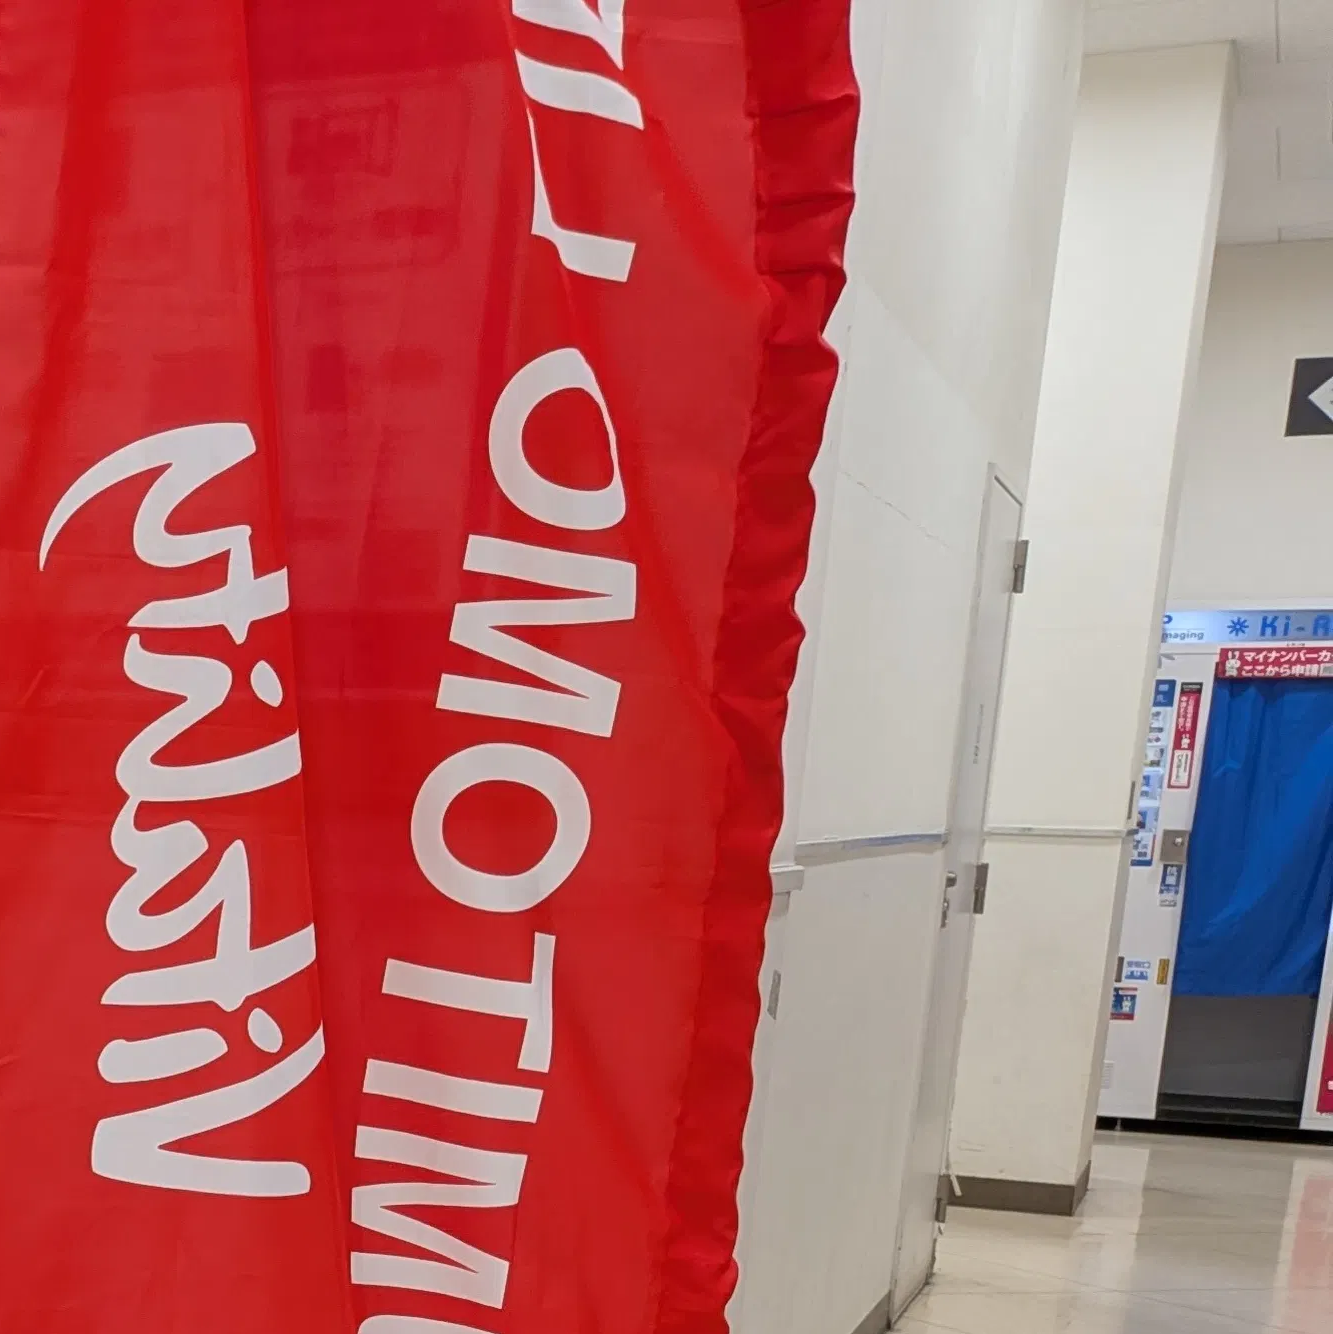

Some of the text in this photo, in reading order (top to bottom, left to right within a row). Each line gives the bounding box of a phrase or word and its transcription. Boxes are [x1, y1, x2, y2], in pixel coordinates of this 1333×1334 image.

[1243, 649, 1333, 662] マイナンバーカ
